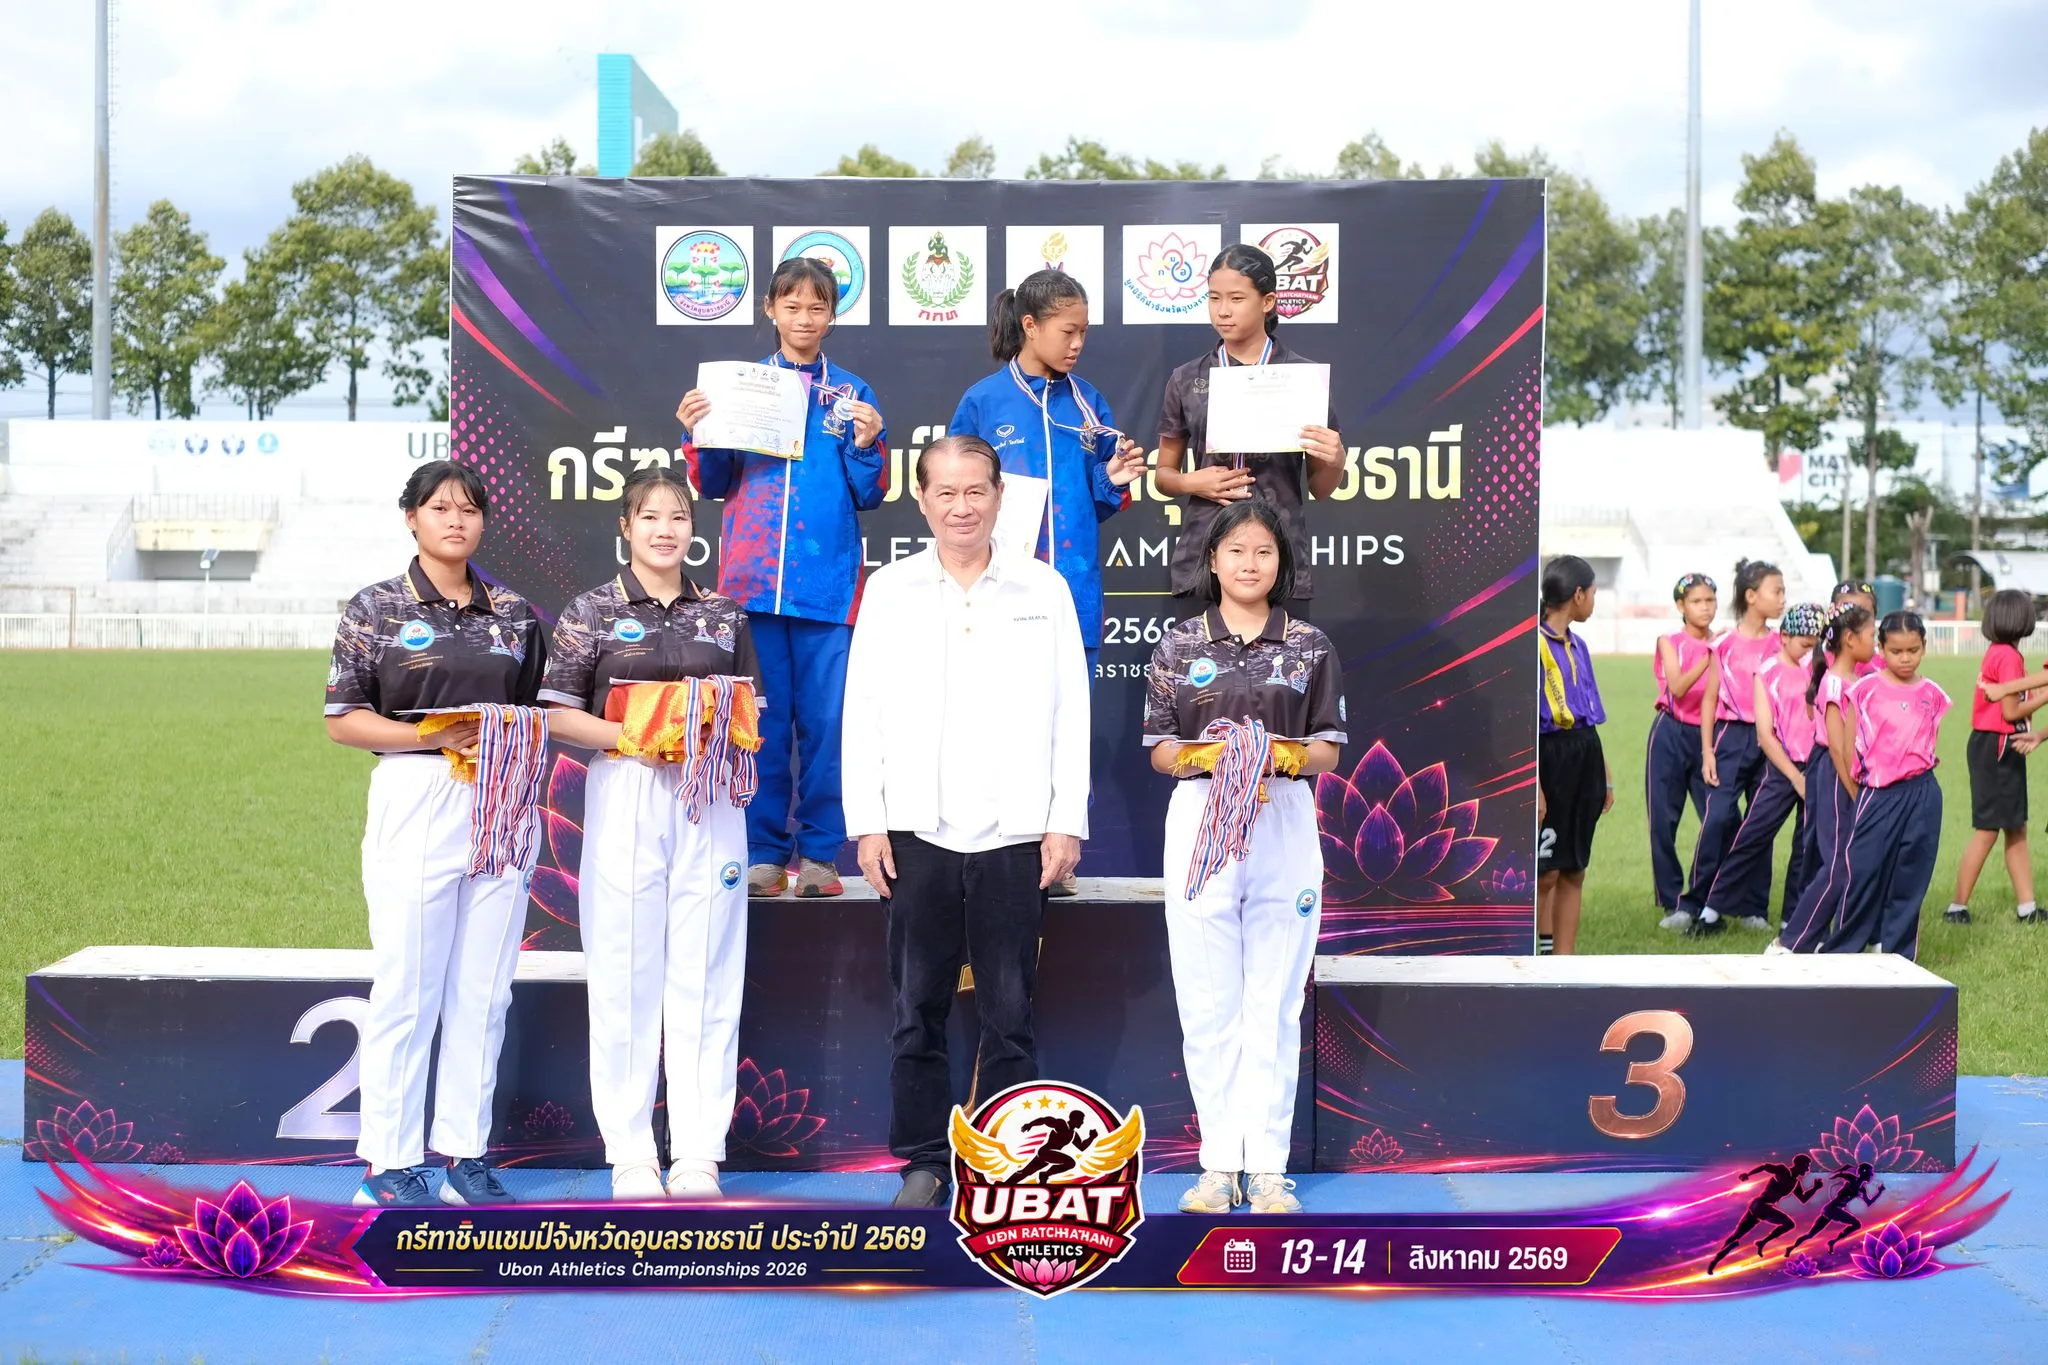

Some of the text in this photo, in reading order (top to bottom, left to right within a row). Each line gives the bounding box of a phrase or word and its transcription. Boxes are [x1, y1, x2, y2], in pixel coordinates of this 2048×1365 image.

[1276, 274, 1323, 292] BAT
[275, 996, 371, 1140] 2
[1588, 1009, 1694, 1139] 3
